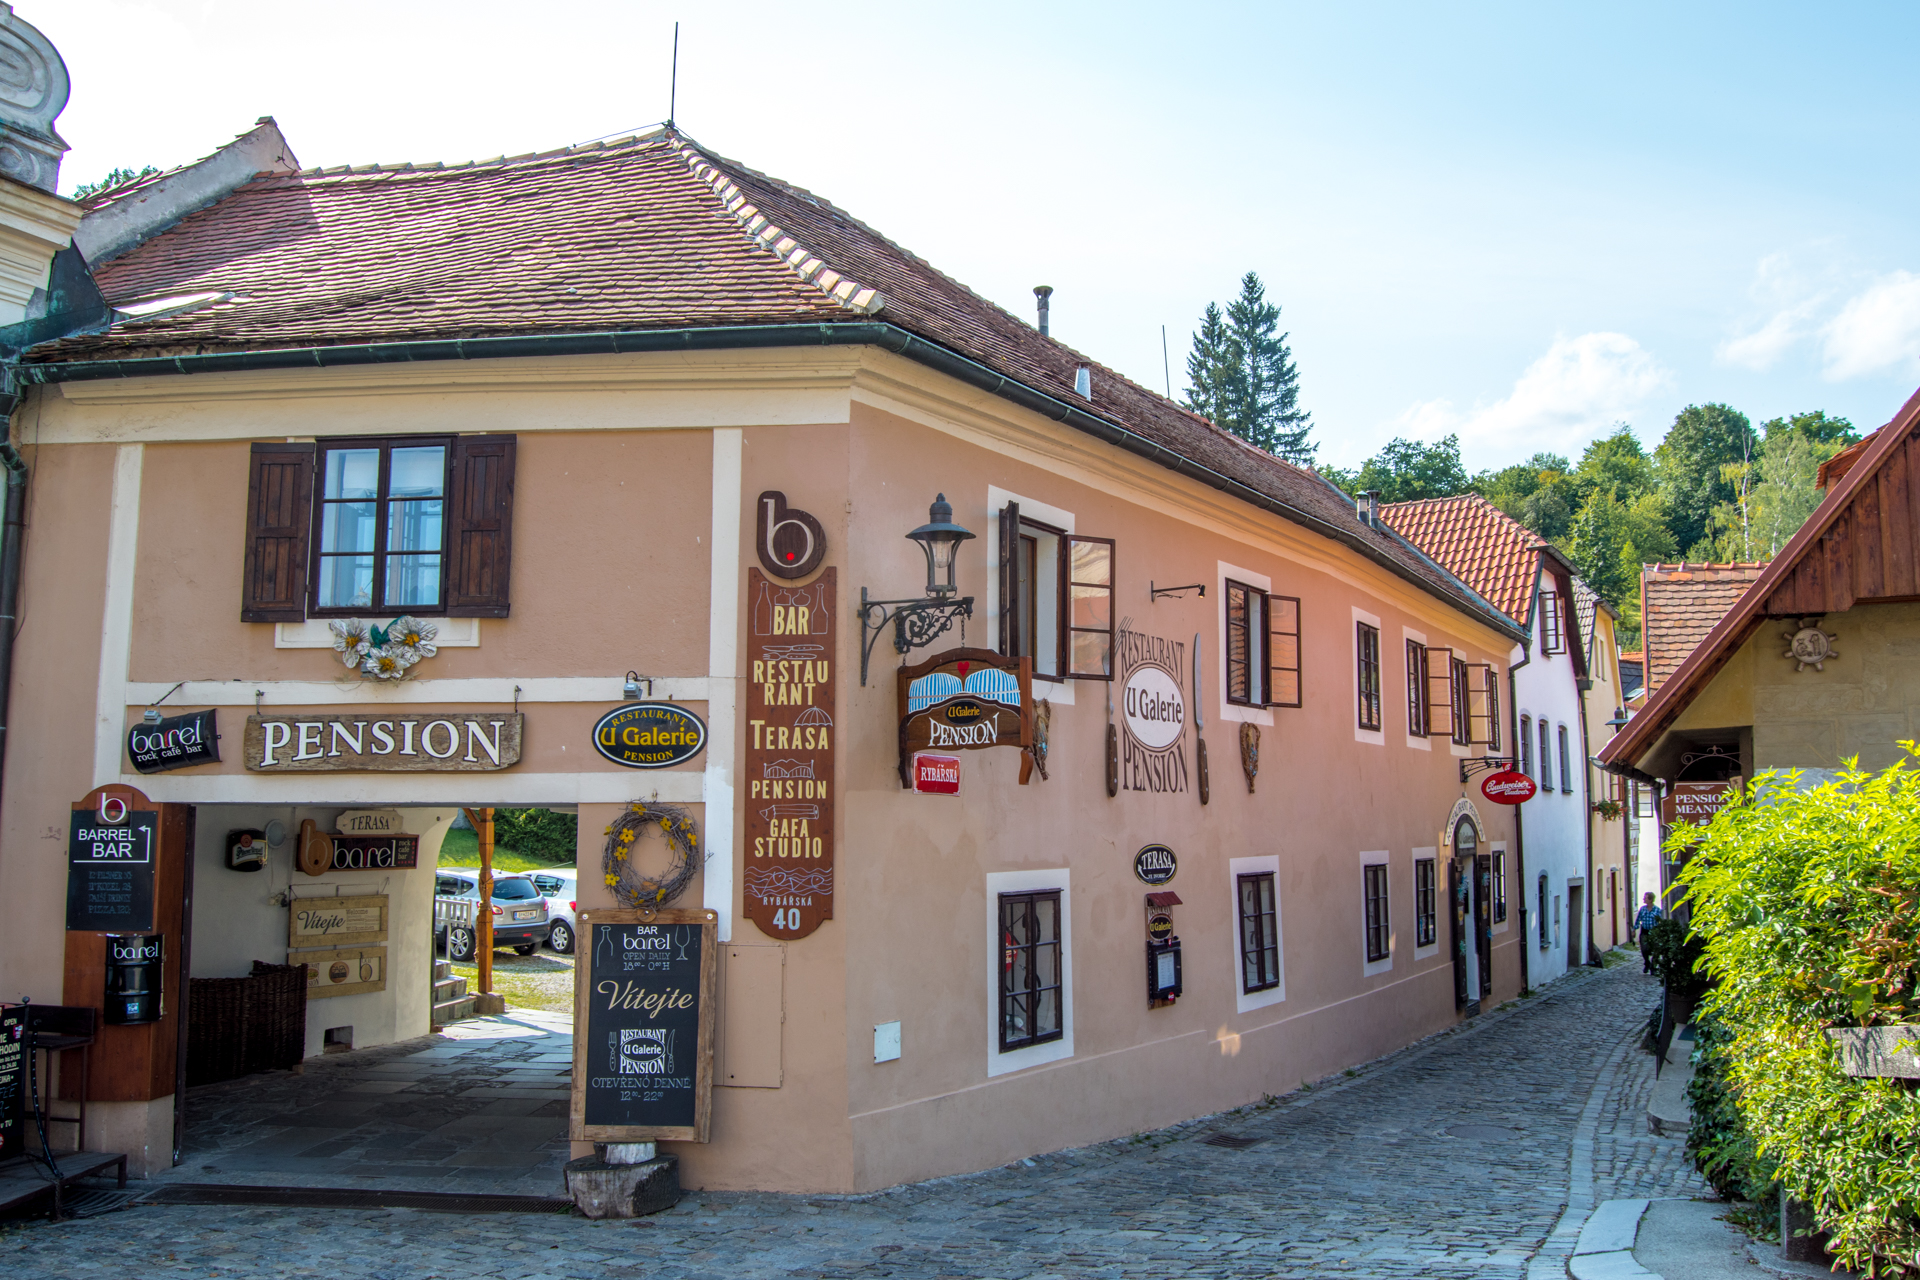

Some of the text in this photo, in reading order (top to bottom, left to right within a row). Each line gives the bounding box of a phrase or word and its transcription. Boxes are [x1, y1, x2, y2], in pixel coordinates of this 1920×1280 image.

[773, 605, 809, 635] BAR
[1121, 629, 1185, 690] RESTAURANT
[753, 660, 829, 684] RESTAU
[763, 683, 817, 706] RANT
[948, 705, 980, 717] U Galerie
[1127, 687, 1183, 724] U Galerie
[611, 709, 688, 727] RESTAURANT
[600, 727, 698, 746] U Galerie
[750, 720, 829, 750] TERASA
[927, 712, 999, 747] PENSION
[136, 744, 203, 762] rock café bar
[260, 720, 506, 768] PENSION
[623, 750, 674, 762] PENSION
[1121, 719, 1189, 794] PENSION
[921, 764, 958, 783] RYBÁŘSKÁ
[751, 780, 827, 799] PENSION
[351, 815, 390, 830] TERASA
[769, 818, 809, 838] GAFA
[78, 829, 137, 841] BARREL
[92, 843, 133, 858] BAR
[754, 837, 823, 859] STUDIO
[1141, 851, 1172, 870] TERASA
[763, 895, 812, 906] RYBÁŘSKÁ
[297, 911, 346, 934] Vítejte
[773, 907, 801, 931] 40
[1154, 922, 1172, 931] Galerie
[637, 926, 658, 935] BAR
[113, 942, 159, 959] barel
[622, 952, 671, 961] OPEN DAILY
[597, 979, 694, 1019] Vítejte
[620, 1028, 667, 1046] RESTAURANT
[623, 1044, 662, 1055] U Galerie
[619, 1053, 666, 1074] PENSION
[653, 1076, 692, 1089] DENNĚ
